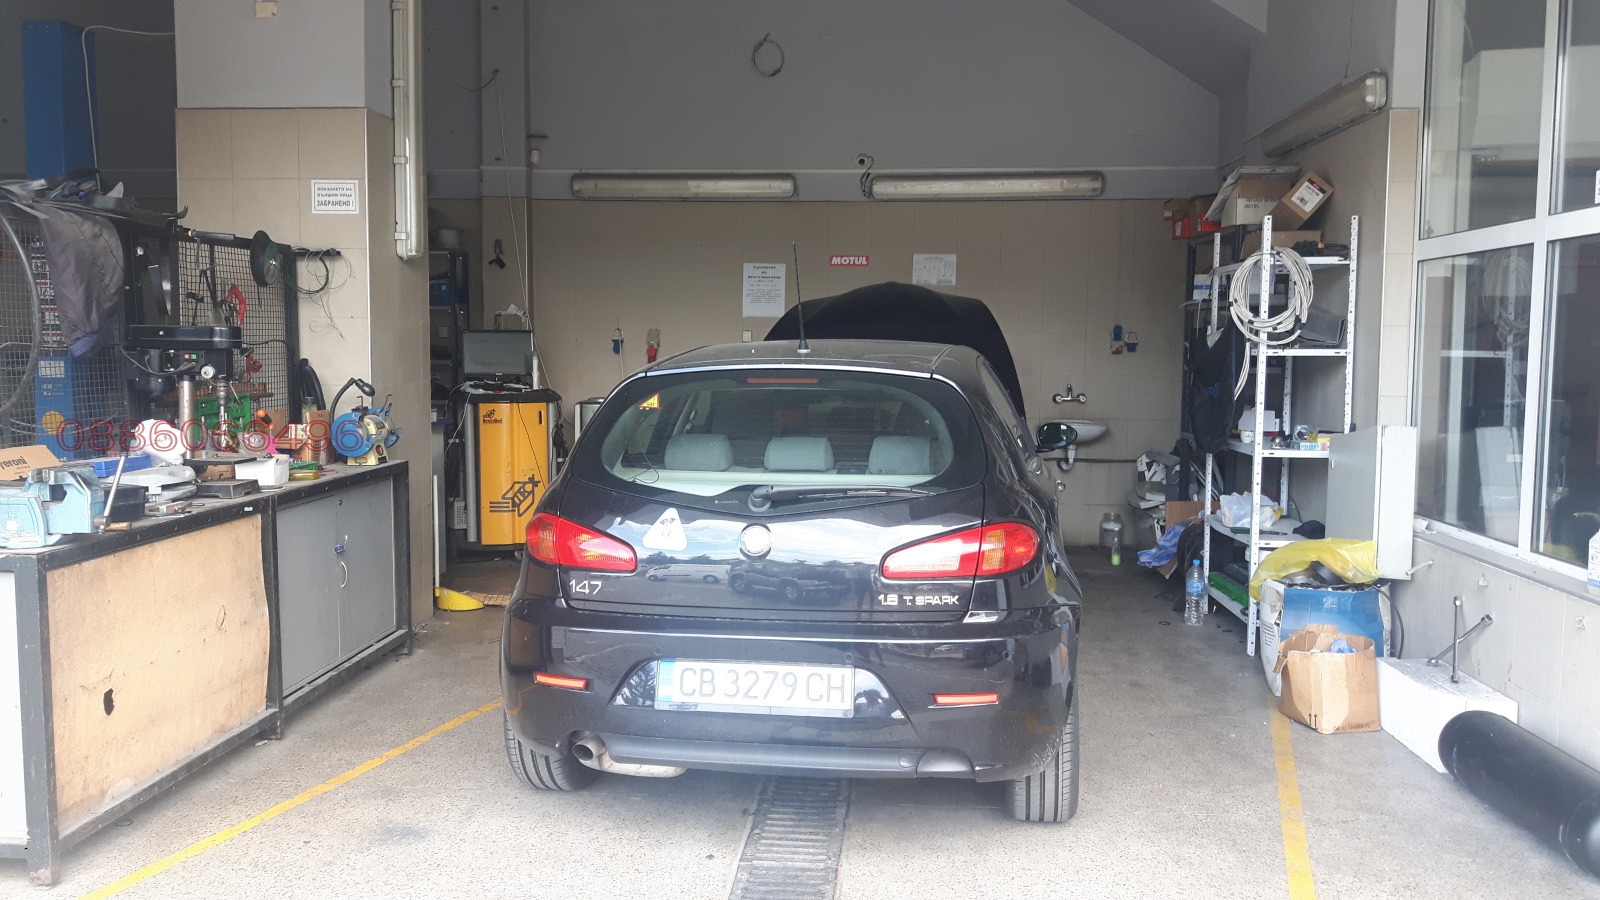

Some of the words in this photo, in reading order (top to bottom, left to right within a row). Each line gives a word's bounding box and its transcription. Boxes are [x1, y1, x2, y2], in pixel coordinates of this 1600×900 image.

[831, 256, 868, 265] MOTUL
[569, 579, 603, 595] 147
[679, 667, 717, 698] CB
[723, 669, 798, 701] 3279
[806, 672, 846, 704] CH
